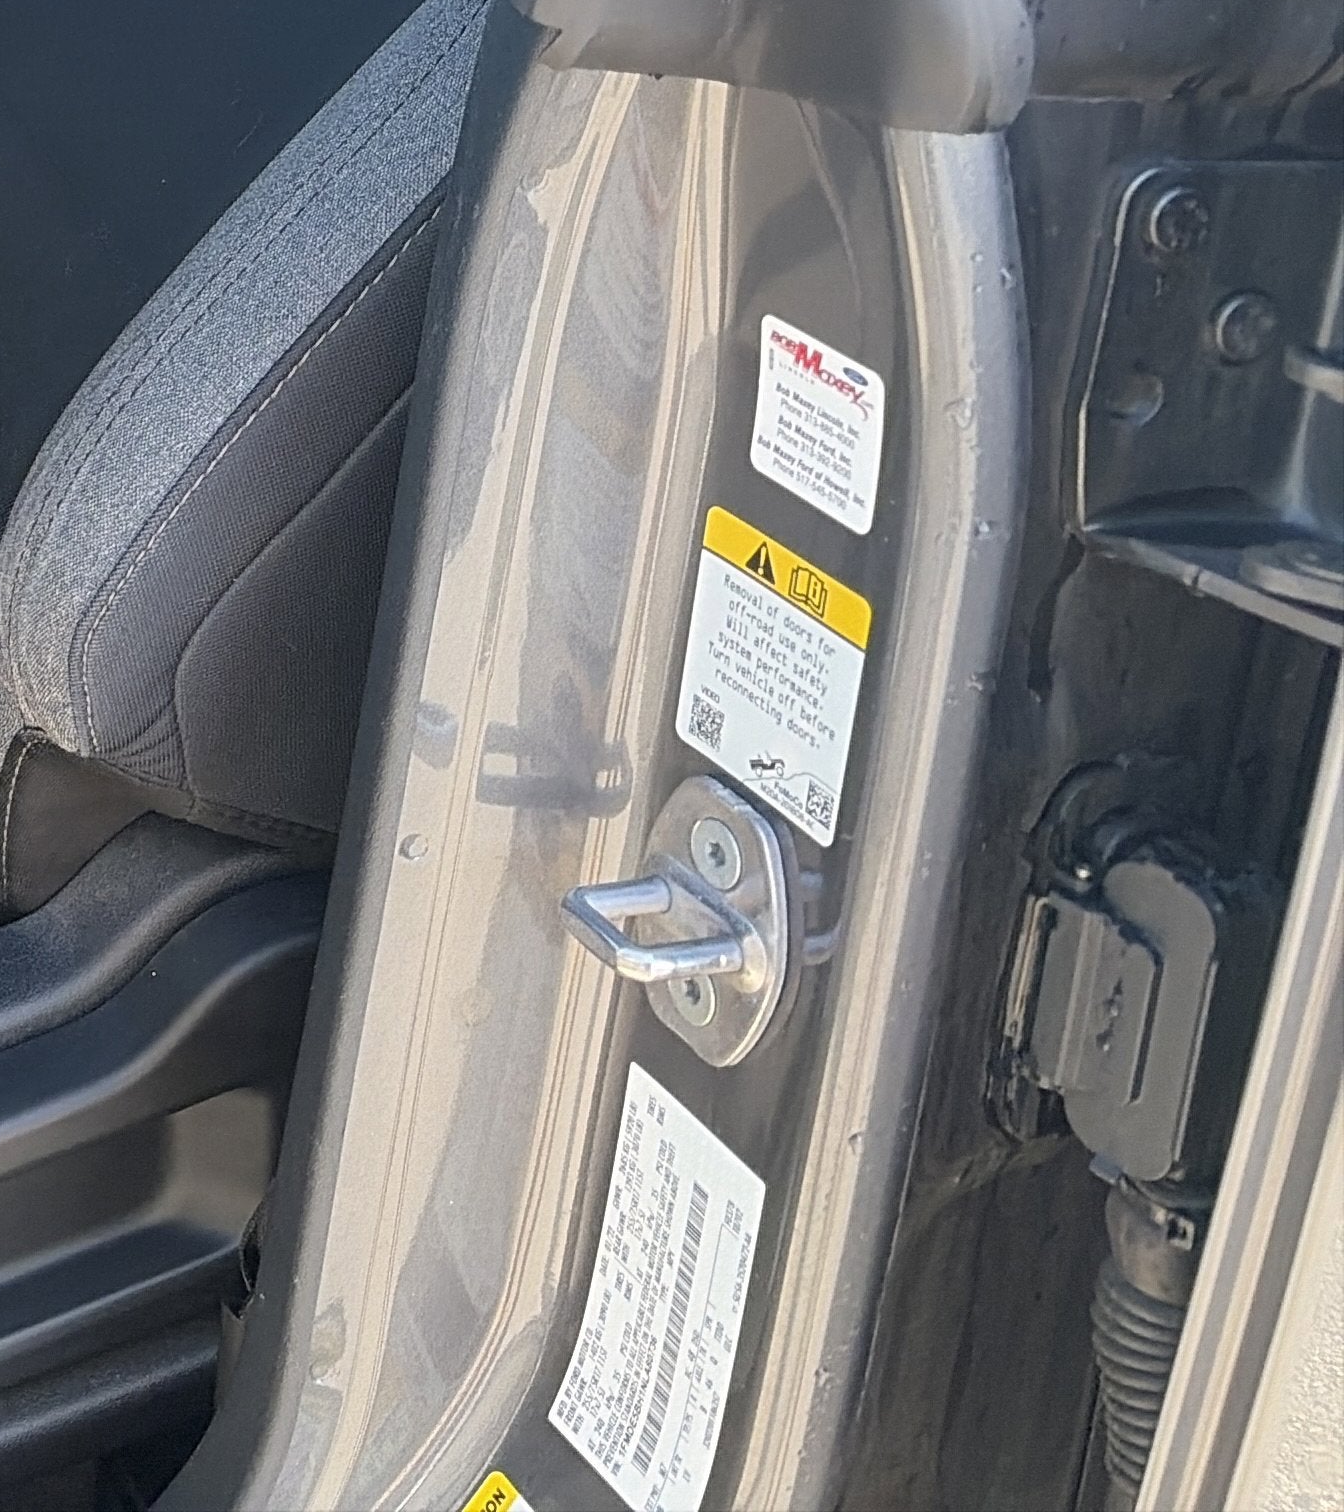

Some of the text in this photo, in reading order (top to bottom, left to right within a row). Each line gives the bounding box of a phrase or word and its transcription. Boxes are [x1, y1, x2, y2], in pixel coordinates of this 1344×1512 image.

[775, 381, 790, 397] Bob
[791, 390, 816, 413] Maxey
[779, 397, 802, 418] Phone
[775, 426, 799, 448] Phone
[776, 413, 793, 430] Bob
[793, 424, 818, 447] Maxey
[756, 433, 771, 450] Bob
[772, 443, 796, 466] Maxey
[795, 458, 814, 476] Ford
[771, 456, 795, 478] Phone
[723, 573, 836, 657] Removal of doors for
[728, 599, 829, 674] off-road use only.
[717, 630, 823, 710] system performance.
[725, 614, 828, 697] Will affect safety
[700, 684, 720, 704] VIDEO
[707, 639, 835, 741] Turn vehicle off before
[714, 668, 820, 749] reconnecting doors.
